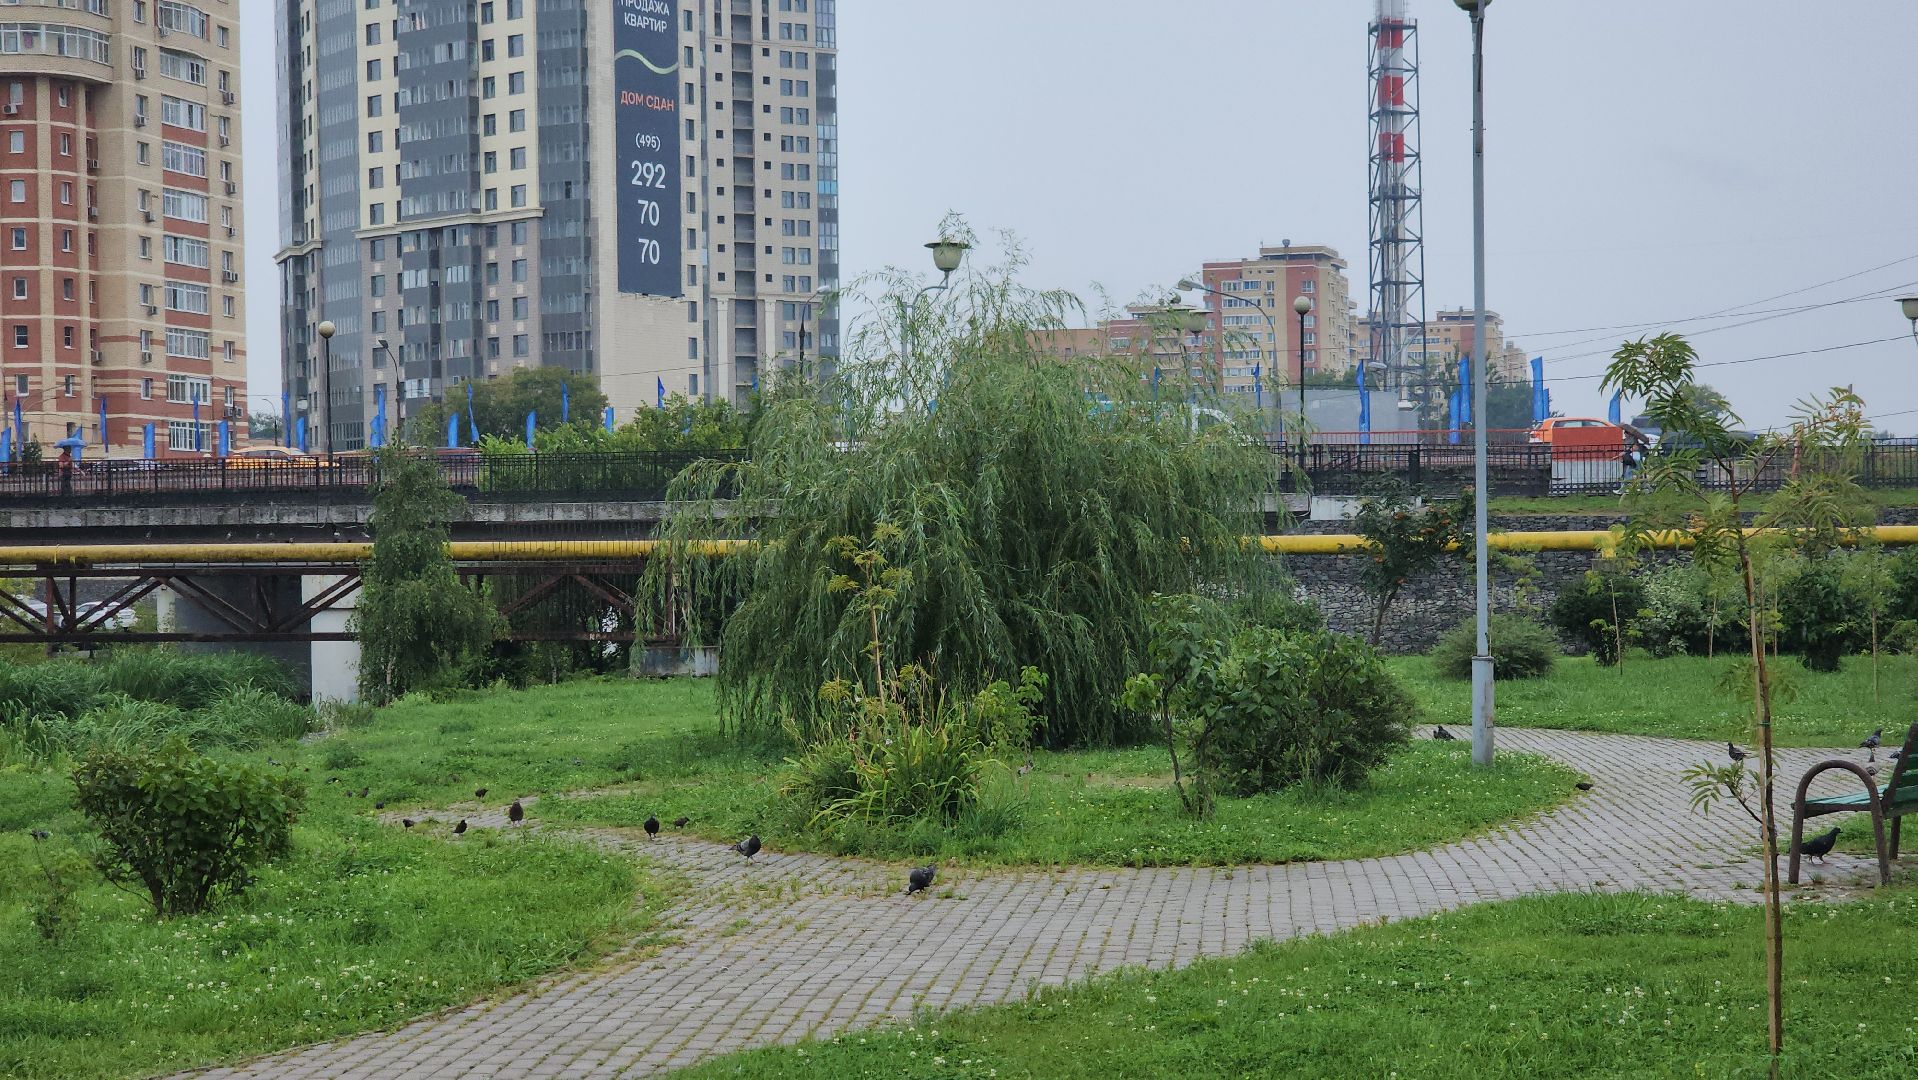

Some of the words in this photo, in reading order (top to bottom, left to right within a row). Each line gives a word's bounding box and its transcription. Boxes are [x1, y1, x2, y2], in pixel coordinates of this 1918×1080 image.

[624, 12, 668, 33] КВАРТИР
[621, 91, 644, 107] ДОМ
[645, 95, 674, 112] СДАН
[635, 132, 661, 151] (495)
[631, 160, 666, 189] 292
[637, 199, 660, 226] 70
[638, 238, 660, 265] 70
